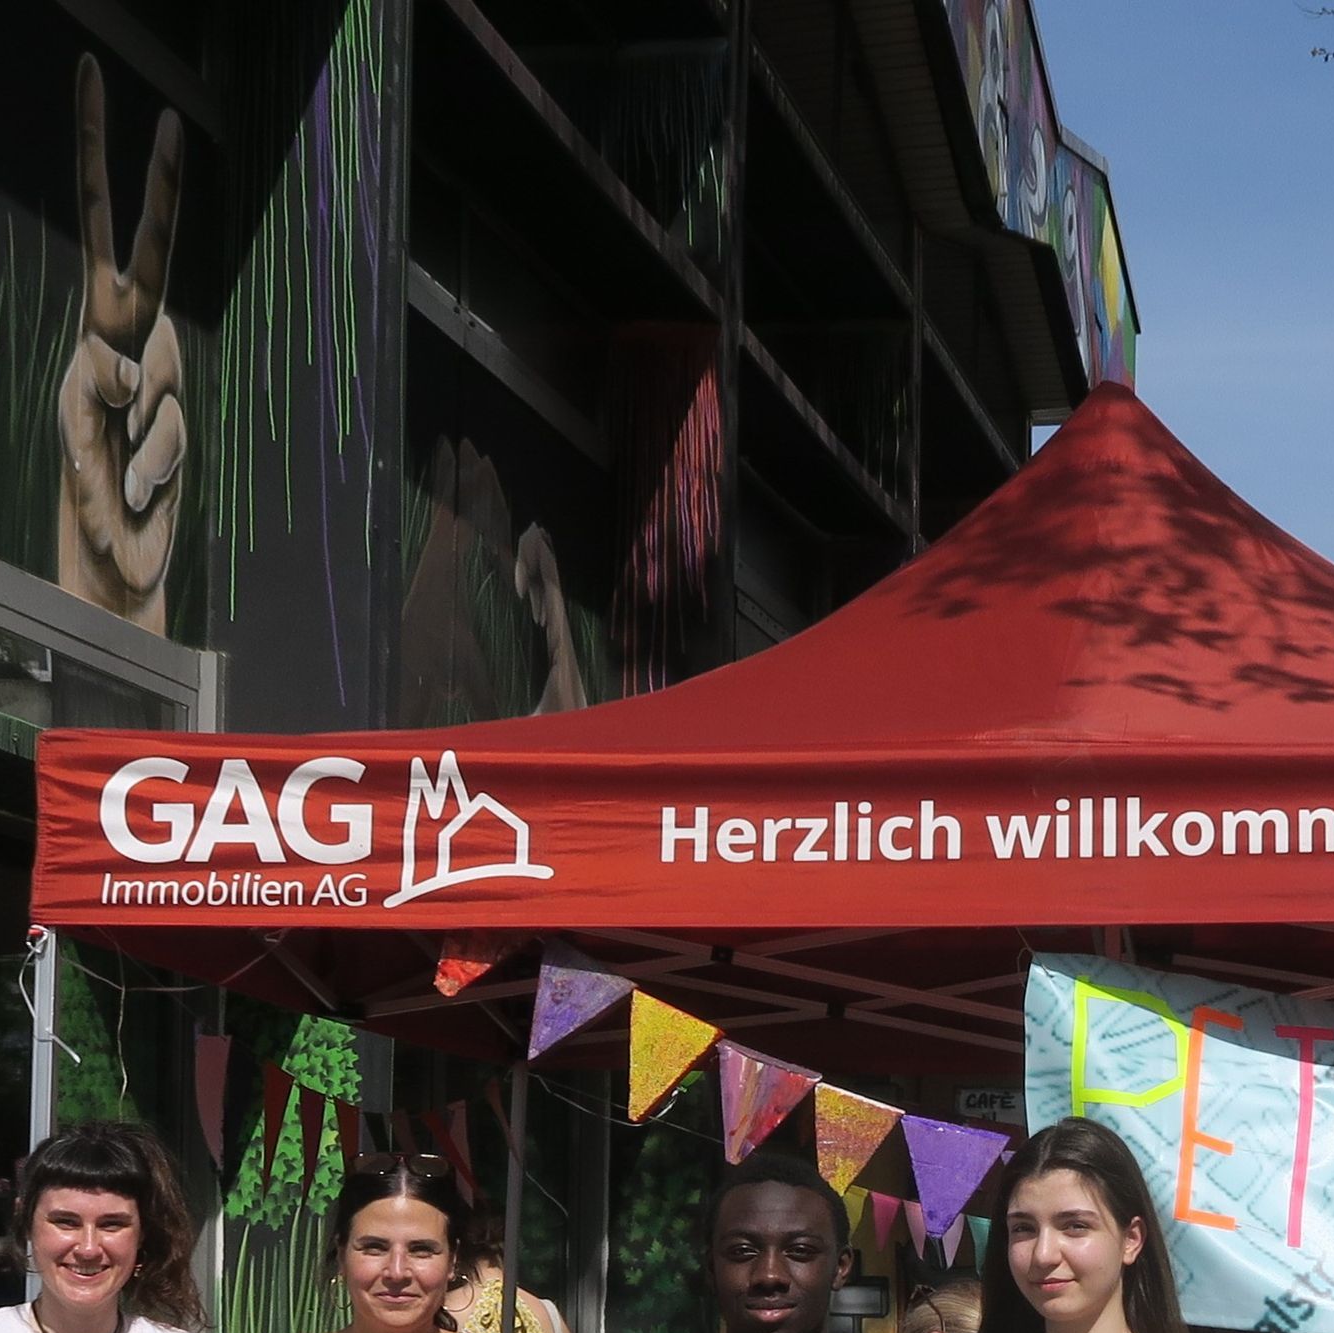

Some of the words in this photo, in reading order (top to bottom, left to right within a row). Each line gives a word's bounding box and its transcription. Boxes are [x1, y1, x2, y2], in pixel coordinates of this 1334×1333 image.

[99, 756, 373, 865] GAG
[659, 800, 962, 863] Herzlich
[101, 871, 304, 906] Immobilien
[312, 873, 368, 907] AG
